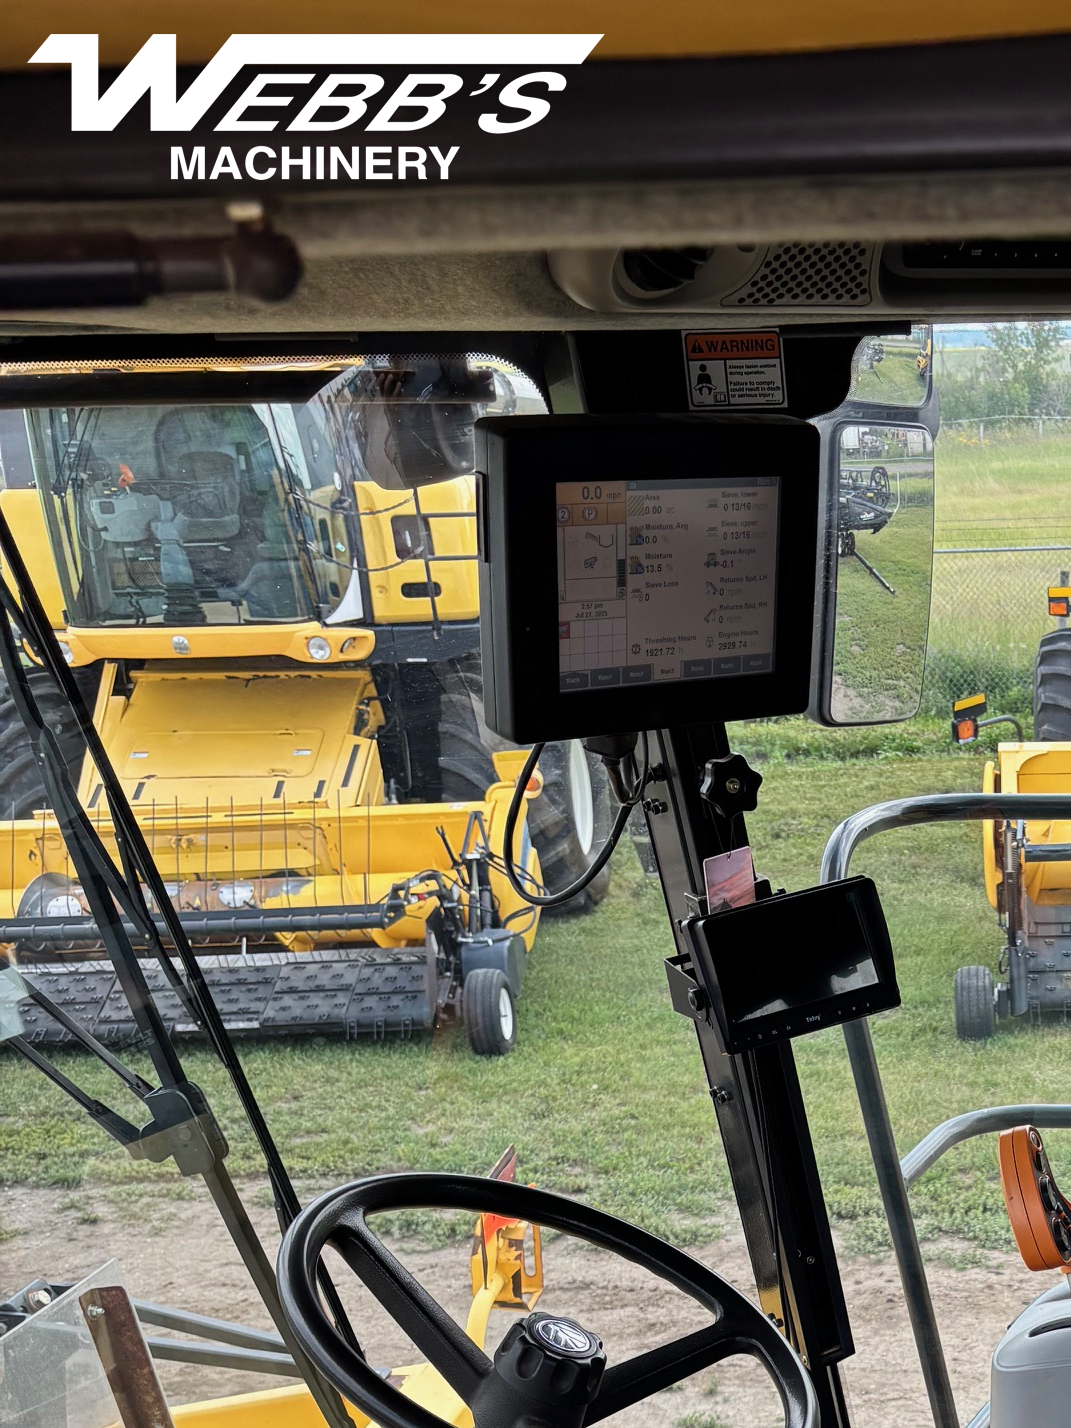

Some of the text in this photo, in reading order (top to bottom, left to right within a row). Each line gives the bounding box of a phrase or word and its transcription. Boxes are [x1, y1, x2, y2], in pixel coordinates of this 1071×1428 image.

[705, 338, 776, 353] WARNING
[582, 486, 602, 500] 0.0
[645, 505, 662, 515] 0.00
[723, 503, 728, 511] 0
[731, 502, 751, 511] 13/16
[560, 510, 566, 519] 2
[676, 522, 689, 531] Avg
[740, 520, 758, 528] upper
[645, 535, 658, 544] 0.0
[722, 532, 728, 540] 0
[730, 530, 751, 540] 13/16
[738, 548, 756, 556] Angle
[645, 563, 662, 573] 13.5
[720, 560, 734, 568] -0.1
[663, 580, 679, 588] Loss
[719, 588, 742, 596] 0 rpm
[645, 593, 650, 602] 0
[718, 616, 742, 624] 0 rpm
[718, 631, 740, 639] Engine
[645, 636, 677, 644] Threshing
[645, 646, 675, 657] 1921.72
